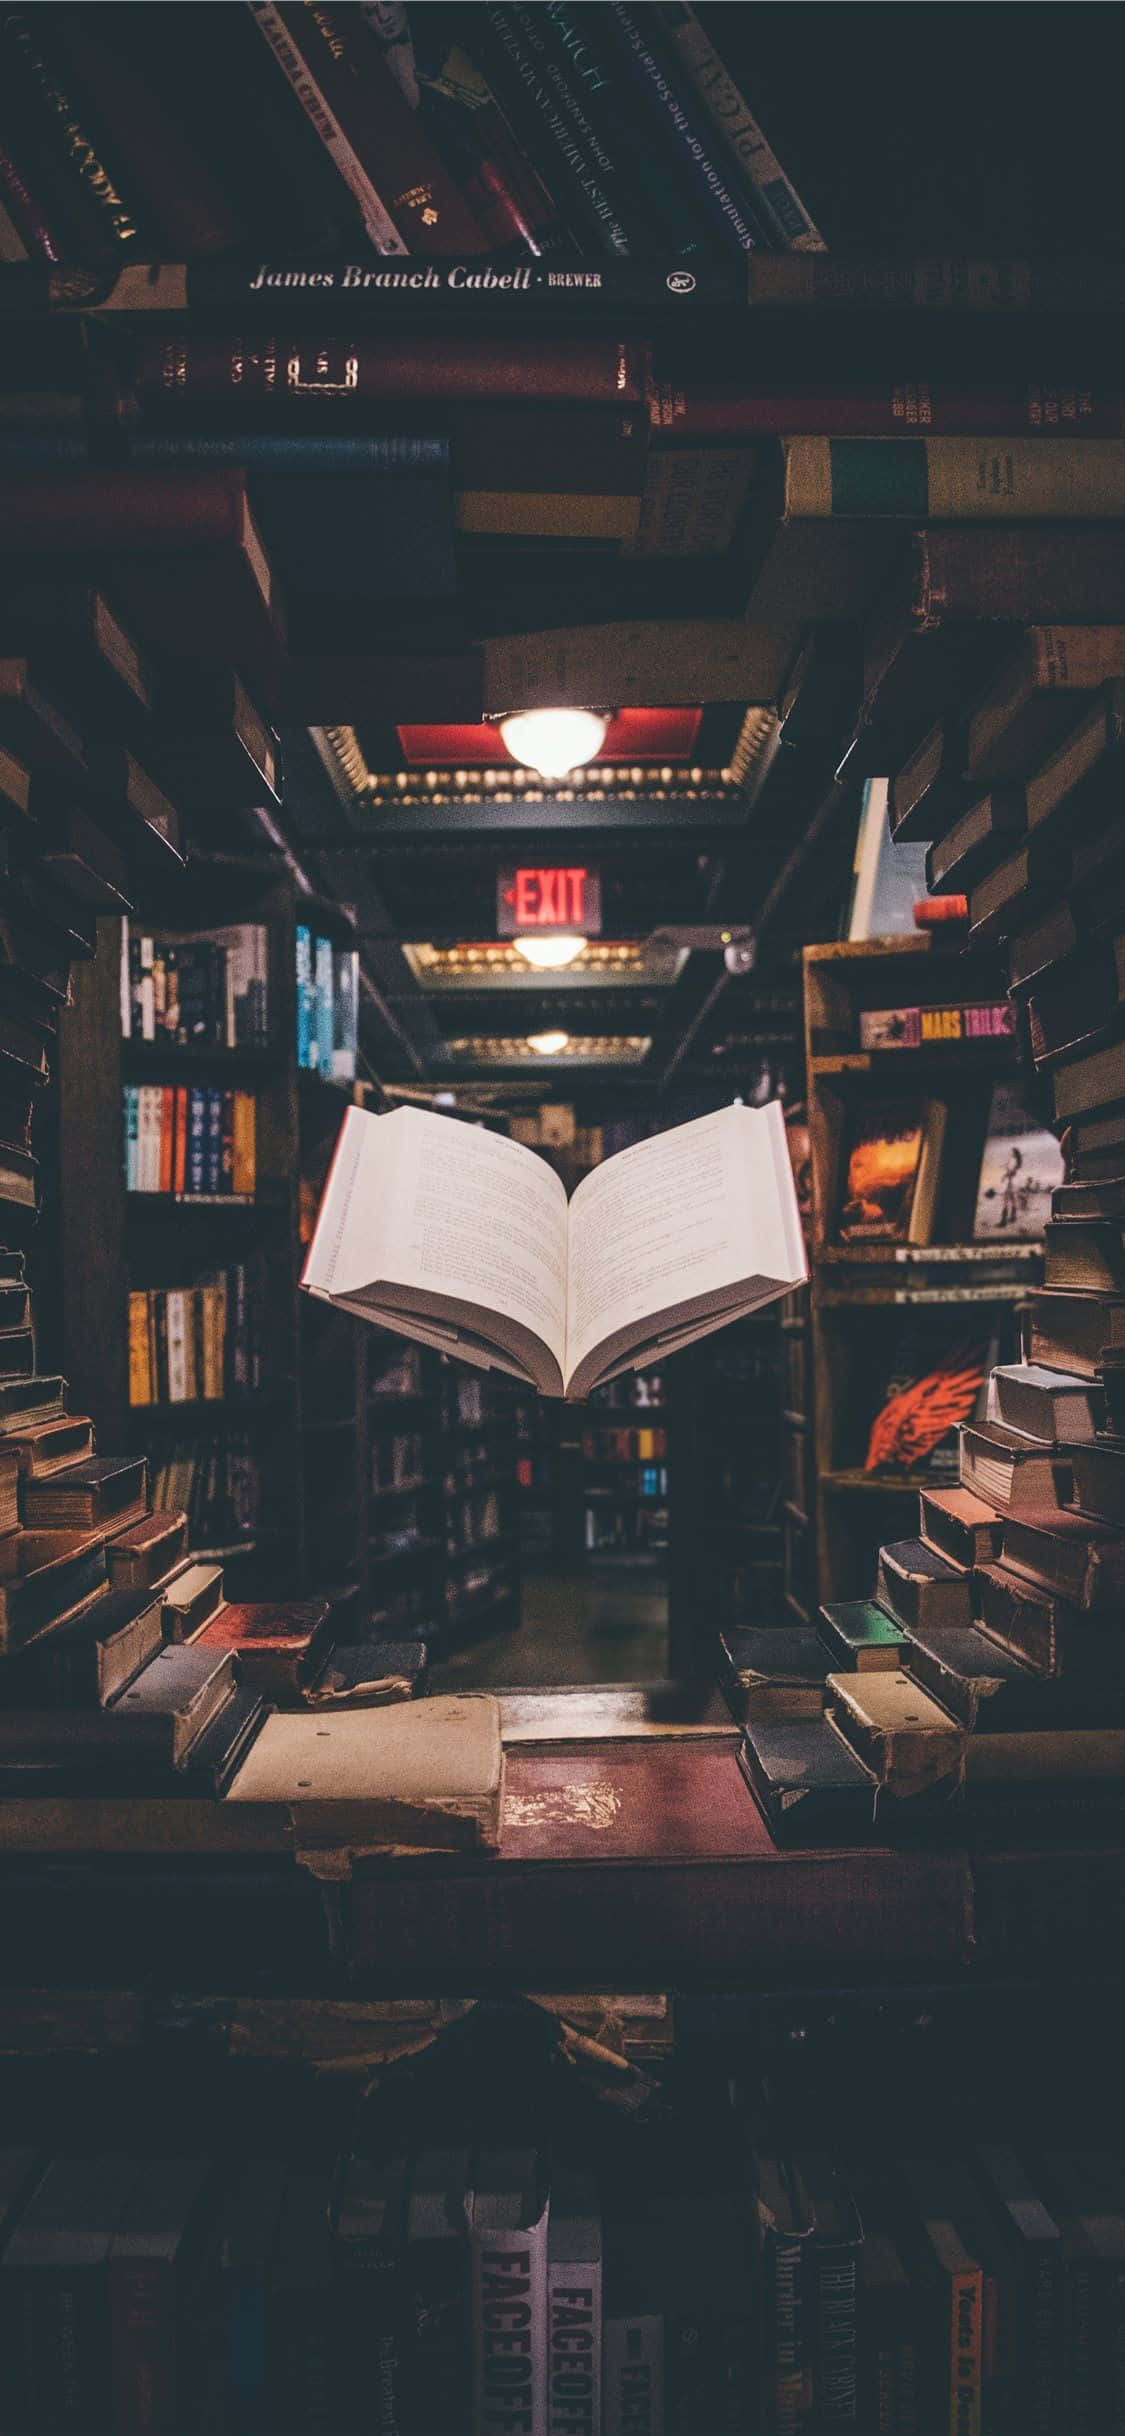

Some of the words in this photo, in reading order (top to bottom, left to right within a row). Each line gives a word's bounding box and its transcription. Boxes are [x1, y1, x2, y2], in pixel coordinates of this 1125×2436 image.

[637, 49, 673, 101] Social
[546, 61, 592, 135] SANDFORD
[665, 100, 690, 132] the
[530, 80, 588, 175] AMERICAN
[683, 132, 706, 161] for
[585, 133, 615, 175] JOHN
[580, 175, 614, 220] BEST
[697, 160, 756, 250] Simulation
[249, 263, 335, 290] James
[340, 263, 440, 289] Branch
[447, 265, 533, 290] Cabell
[547, 272, 602, 289] BREWER
[515, 868, 586, 925] EXIT
[921, 1008, 962, 1040] MARS
[775, 2244, 803, 2333] Murder
[819, 2260, 856, 2294] THE
[481, 2250, 533, 2434] FACEOFF
[552, 2288, 595, 2436] FACEOFF
[775, 2339, 803, 2364] in
